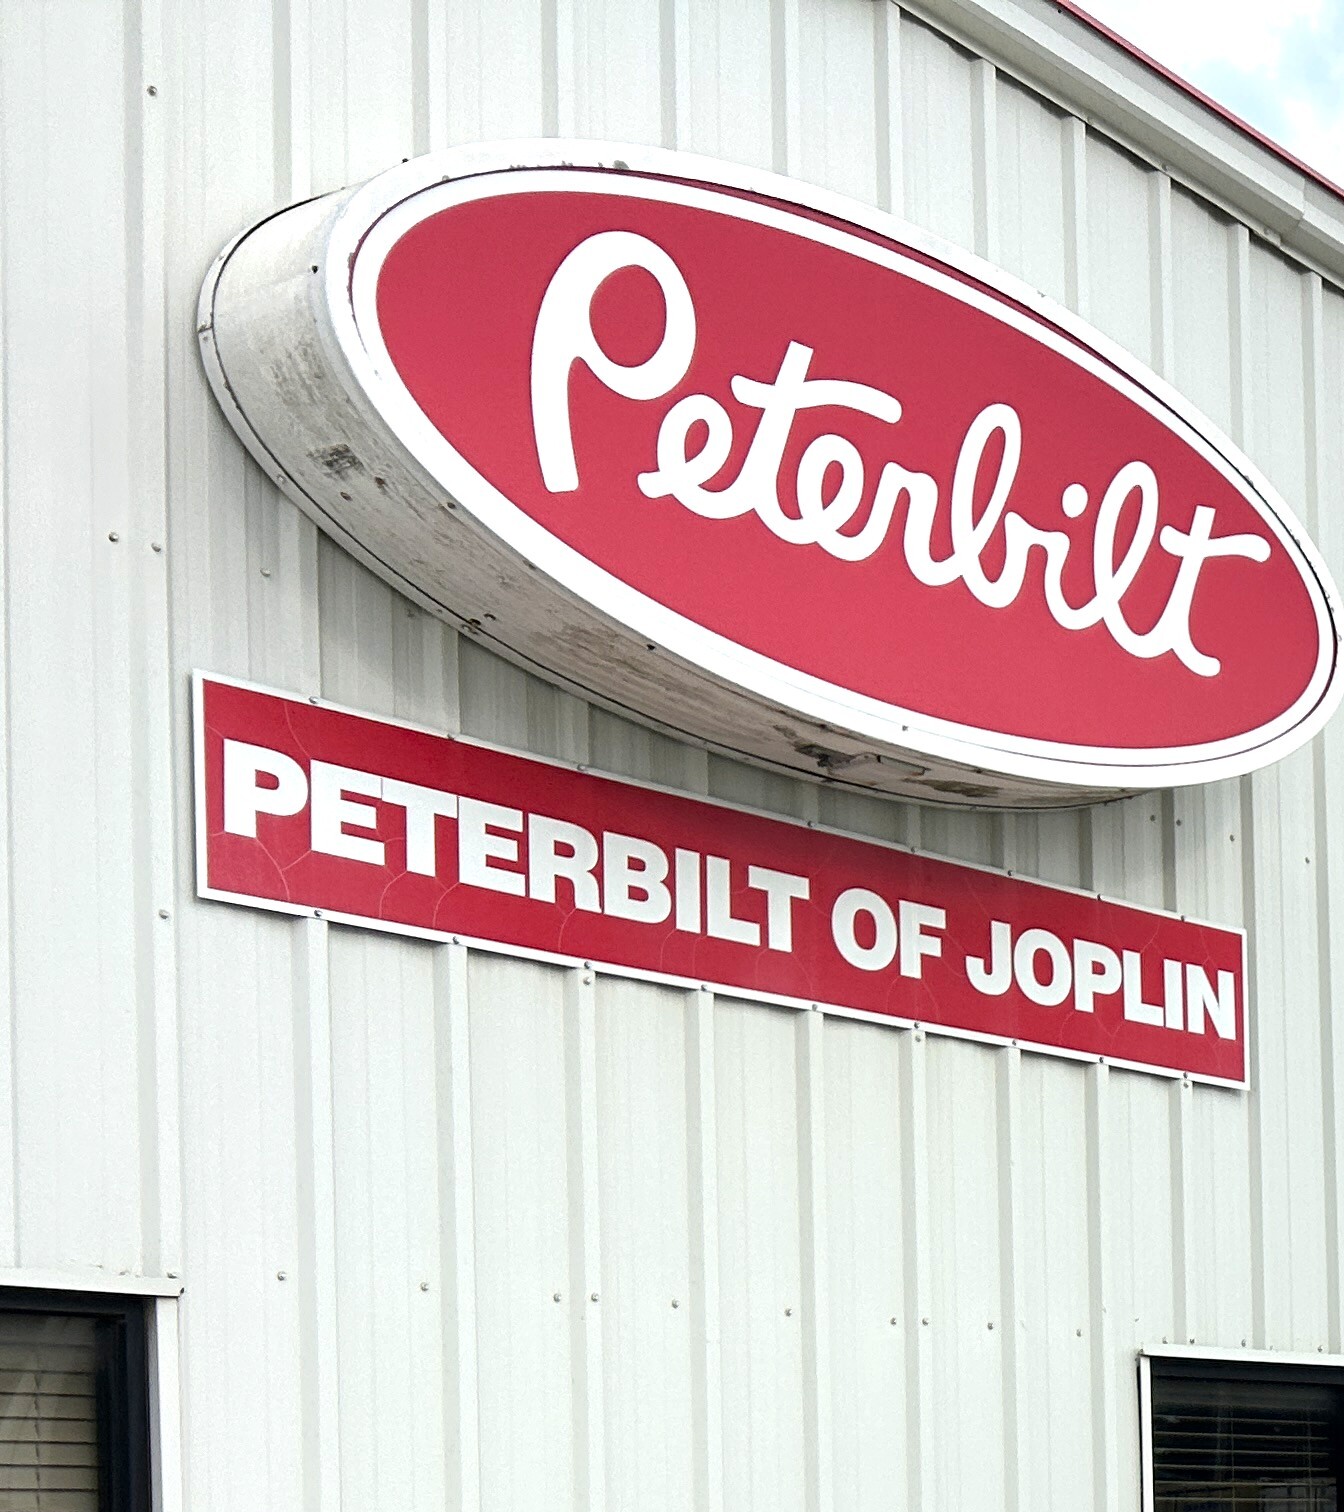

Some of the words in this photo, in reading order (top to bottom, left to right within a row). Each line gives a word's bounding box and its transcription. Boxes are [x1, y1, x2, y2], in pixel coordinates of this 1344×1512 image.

[531, 231, 1271, 677] Peterbilt
[224, 739, 809, 952] PETERBILT
[832, 889, 946, 978] OF
[966, 921, 1236, 1040] JOPLIN
